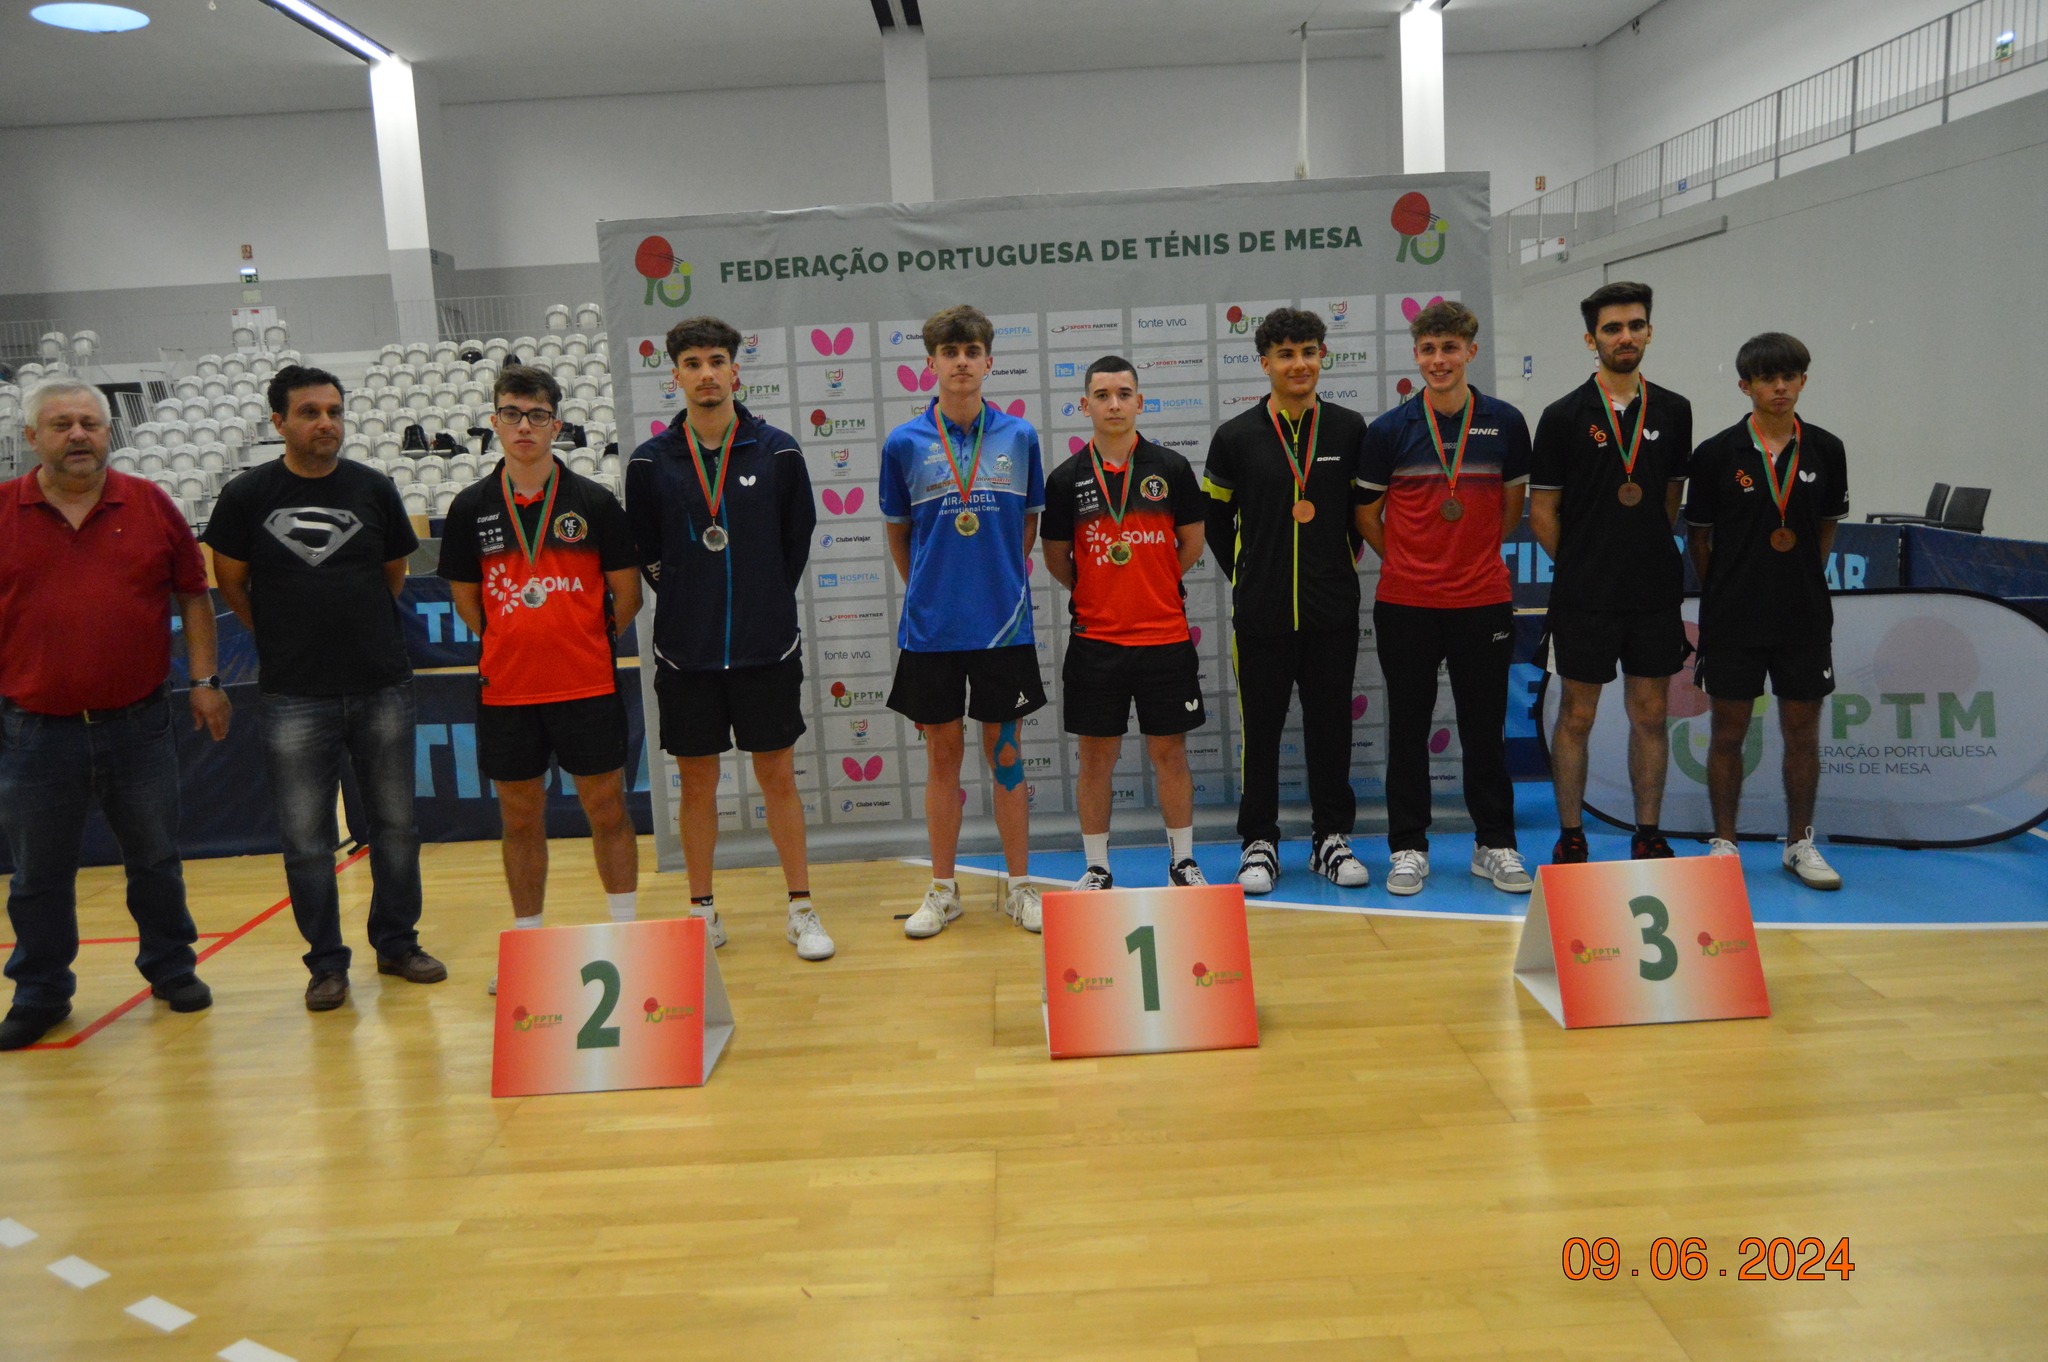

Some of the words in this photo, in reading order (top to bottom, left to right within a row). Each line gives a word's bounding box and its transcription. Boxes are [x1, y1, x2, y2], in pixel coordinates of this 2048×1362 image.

[719, 247, 889, 284] FEDERAÇÃO
[898, 240, 1093, 273] PORTUGUESA
[1101, 238, 1138, 262] DE
[1145, 230, 1230, 259] TÉNIS
[1239, 231, 1275, 255] DE
[1284, 226, 1363, 251] MESA
[1138, 318, 1163, 328] fonte
[1166, 318, 1187, 327] viva
[1223, 354, 1249, 364] fonte
[1335, 352, 1367, 361] FPTM
[750, 384, 780, 394] FPTM
[1337, 390, 1357, 398] viva
[1163, 399, 1203, 407] HOSPITAL
[834, 419, 866, 428] FPTM
[1468, 428, 1499, 436] ONIC
[1121, 530, 1166, 545] SOMA
[840, 573, 880, 581] HOSPITAL
[824, 650, 848, 660] fonte
[850, 650, 871, 659] viva
[853, 691, 883, 700] FPTM
[1831, 691, 1997, 740] PTM
[1817, 743, 1880, 760] ERAÇÃO
[1884, 745, 1998, 759] PORTUGUESA
[1022, 758, 1051, 766] FPTM
[1819, 760, 1855, 775] ÉNIS
[1859, 763, 1881, 775] DE
[1886, 763, 1931, 775] MESA
[1112, 790, 1135, 798] PTM
[1628, 895, 1678, 981] 3
[1592, 947, 1621, 956] FPTM
[1125, 925, 1161, 1011] 1
[1085, 977, 1114, 986] FPTM
[576, 959, 621, 1049] 2
[534, 1014, 563, 1023] FPTM
